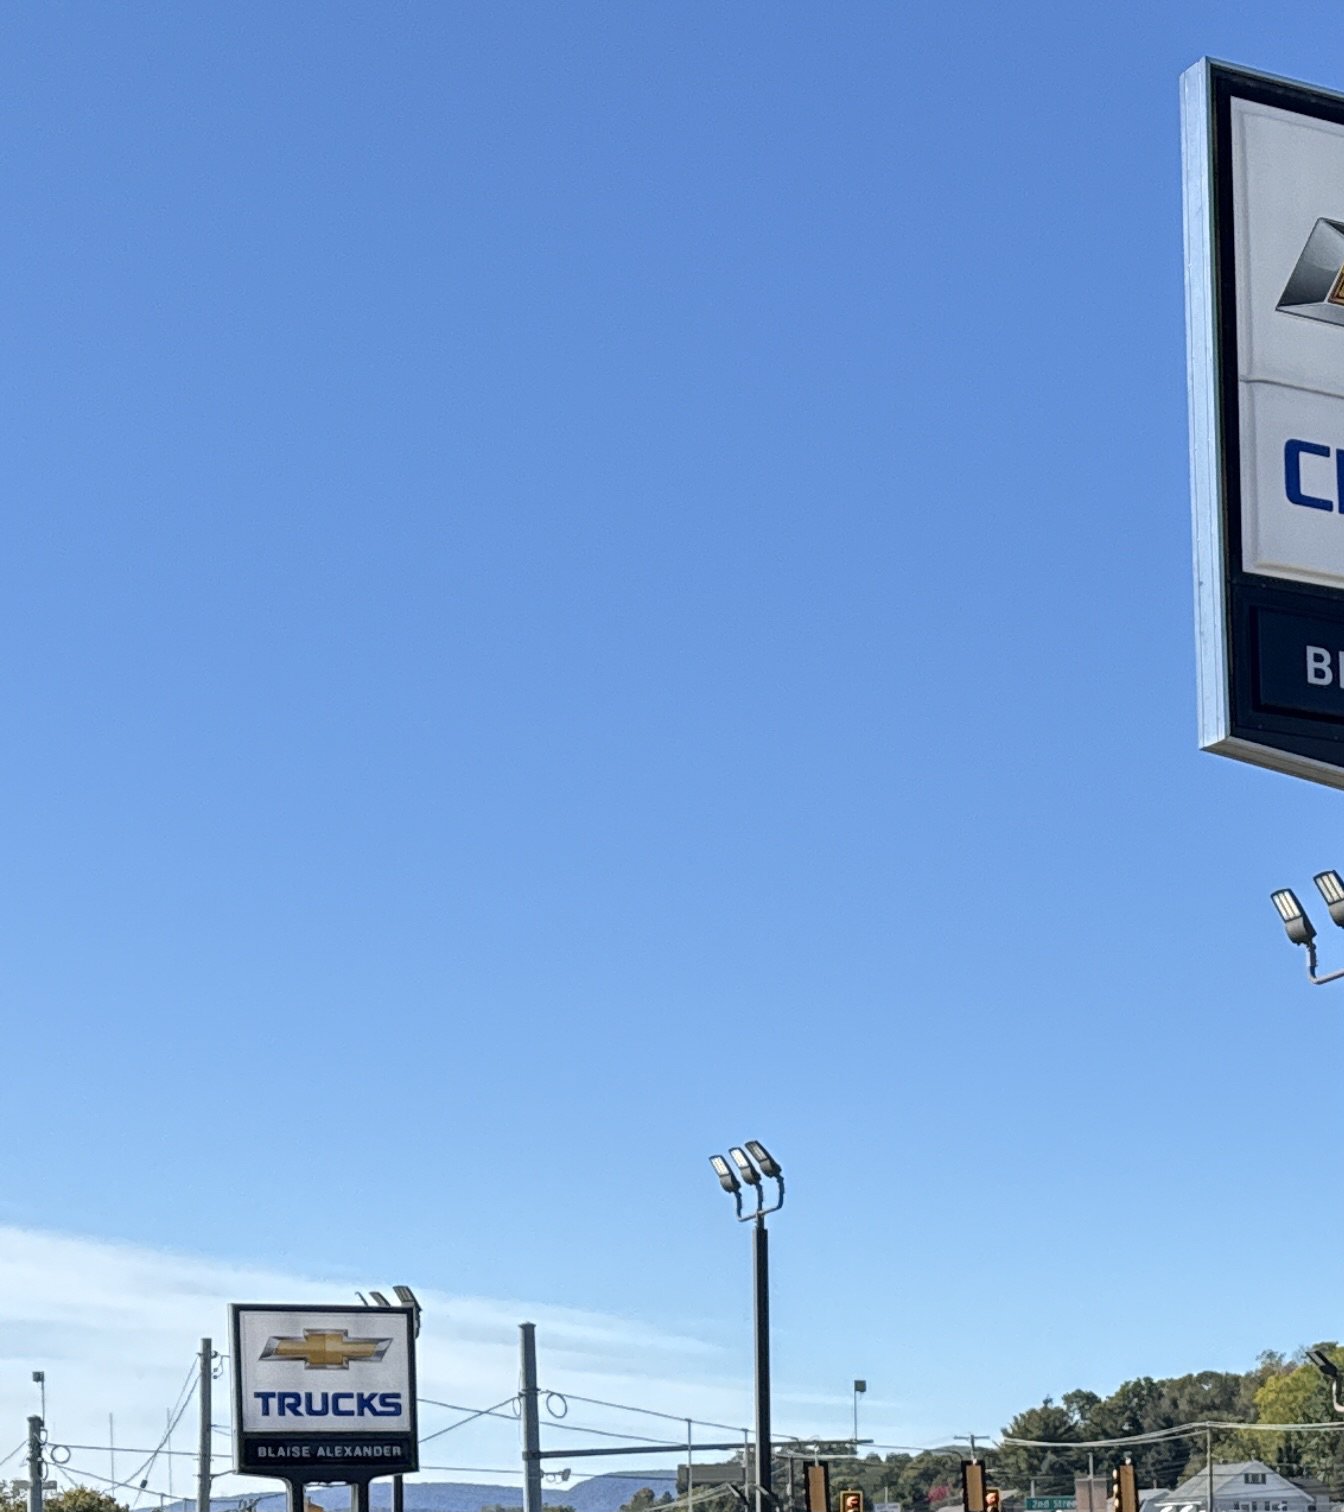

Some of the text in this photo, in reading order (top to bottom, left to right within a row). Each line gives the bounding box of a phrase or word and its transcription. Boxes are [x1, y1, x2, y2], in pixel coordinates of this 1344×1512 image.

[253, 1391, 402, 1417] TRUCKS
[257, 1445, 401, 1458] BLAISE ALEXANDER
